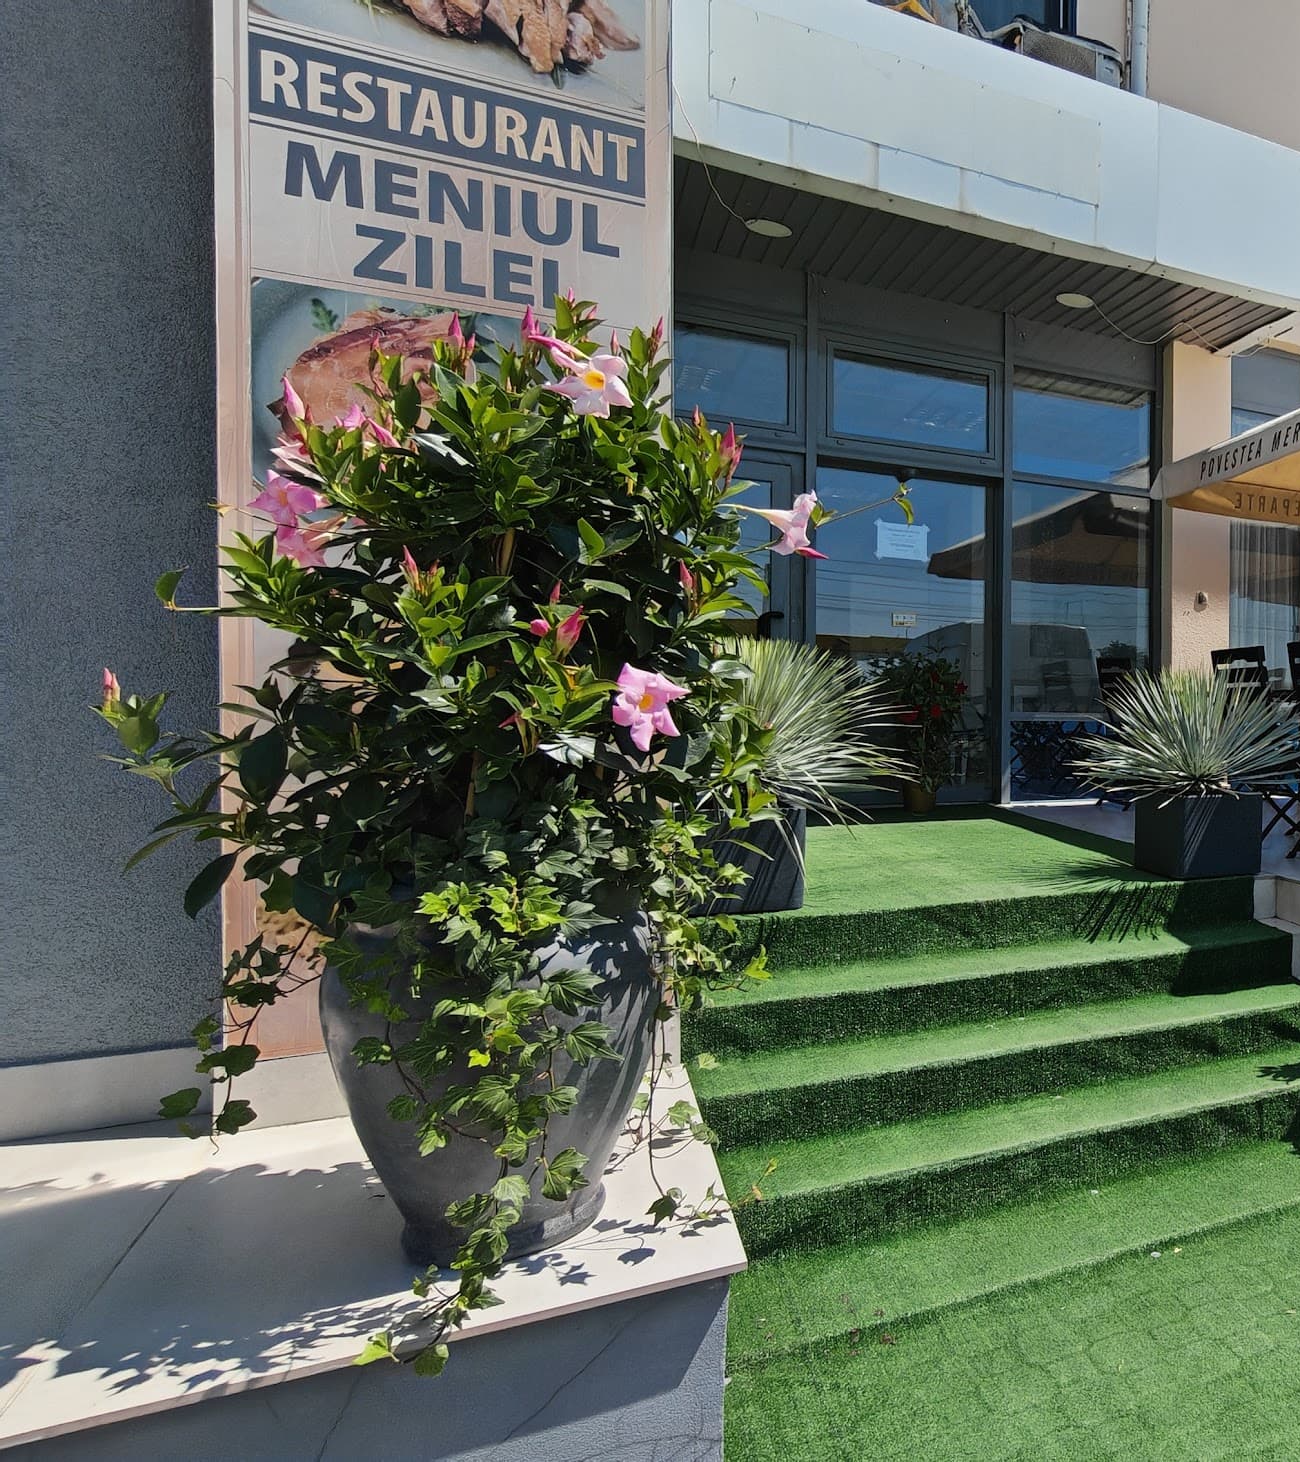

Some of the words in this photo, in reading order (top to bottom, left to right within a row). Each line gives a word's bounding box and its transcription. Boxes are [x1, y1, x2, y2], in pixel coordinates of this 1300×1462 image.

[259, 49, 638, 183] RESTAURANT
[284, 140, 620, 258] MENIUL
[353, 223, 560, 309] ZILEI
[1200, 438, 1262, 481] POVESTEA
